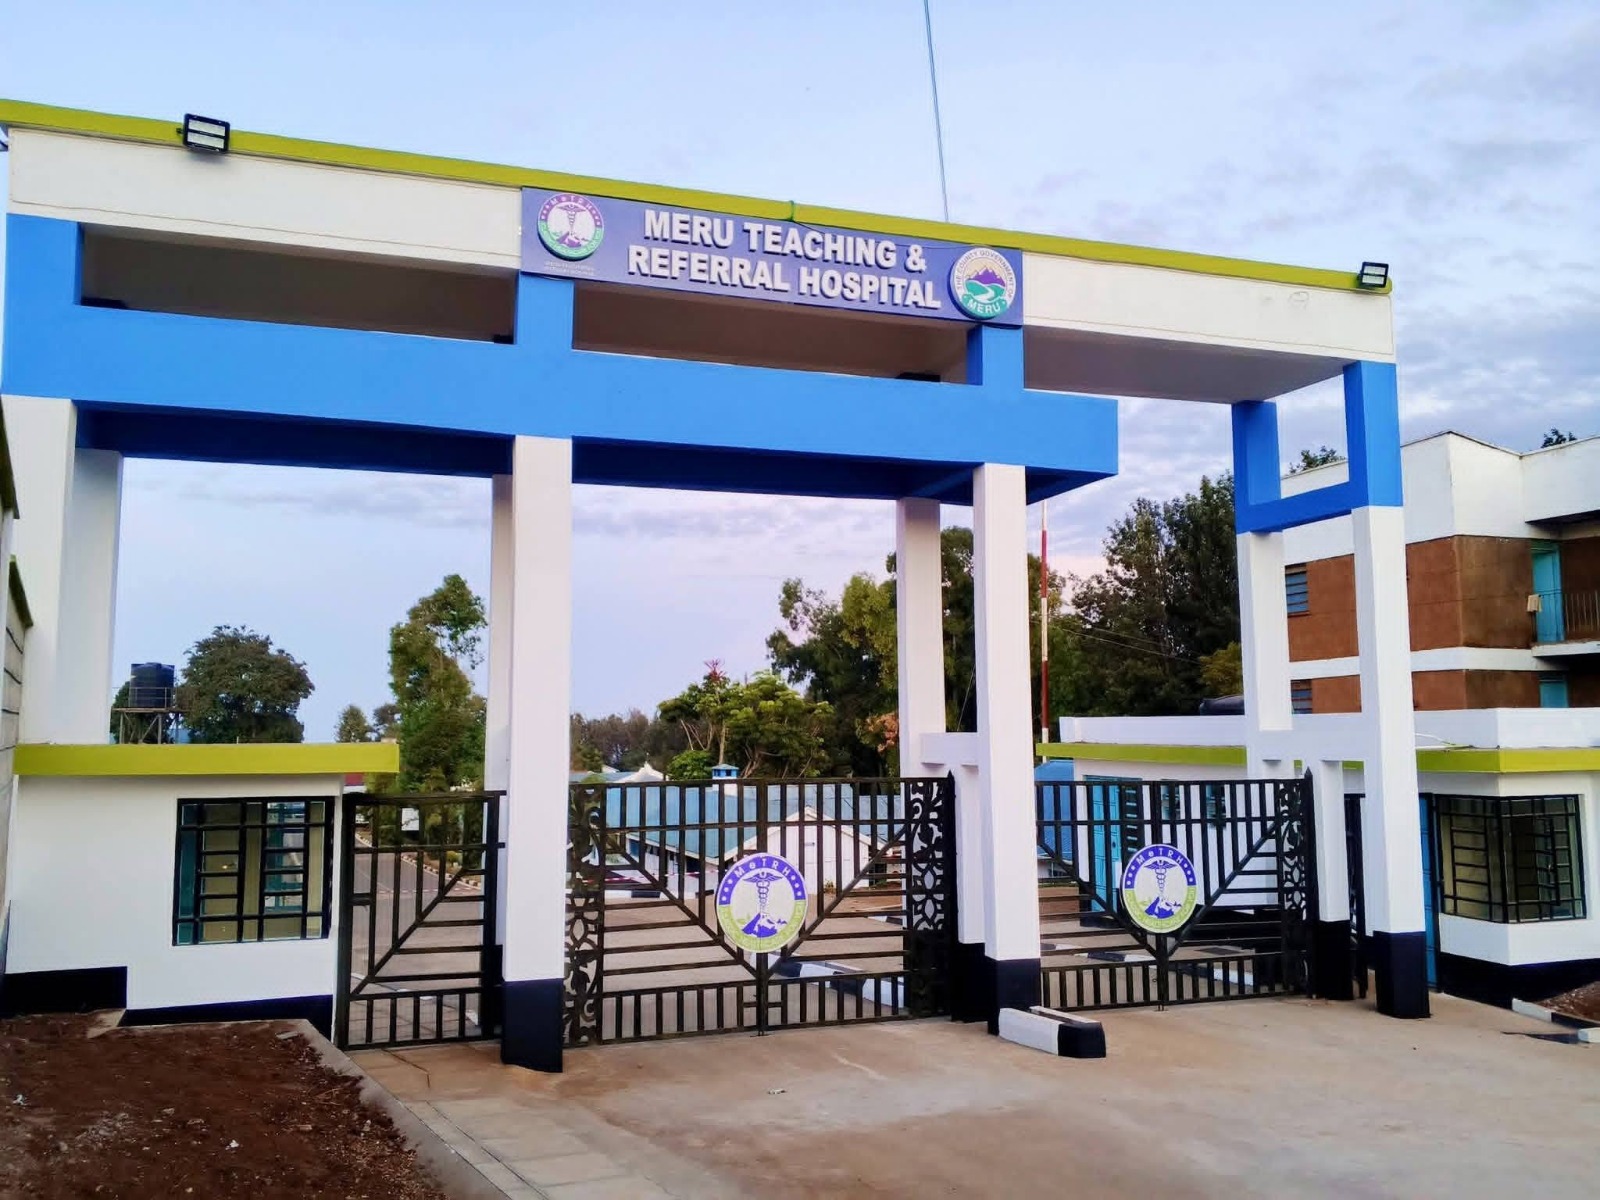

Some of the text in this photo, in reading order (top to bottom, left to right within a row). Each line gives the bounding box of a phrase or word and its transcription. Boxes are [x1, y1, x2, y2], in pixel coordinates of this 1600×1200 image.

[644, 208, 734, 248] MERU
[743, 221, 896, 269] TEACHING
[905, 244, 927, 272] &
[628, 244, 942, 309] REFERRAL HOSPITAL
[957, 251, 978, 275] COUNTY
[980, 250, 1014, 287] GOVERNMENT
[967, 299, 1001, 313] MERU
[734, 858, 791, 878] MeTRH
[1136, 848, 1184, 865] MeTRH
